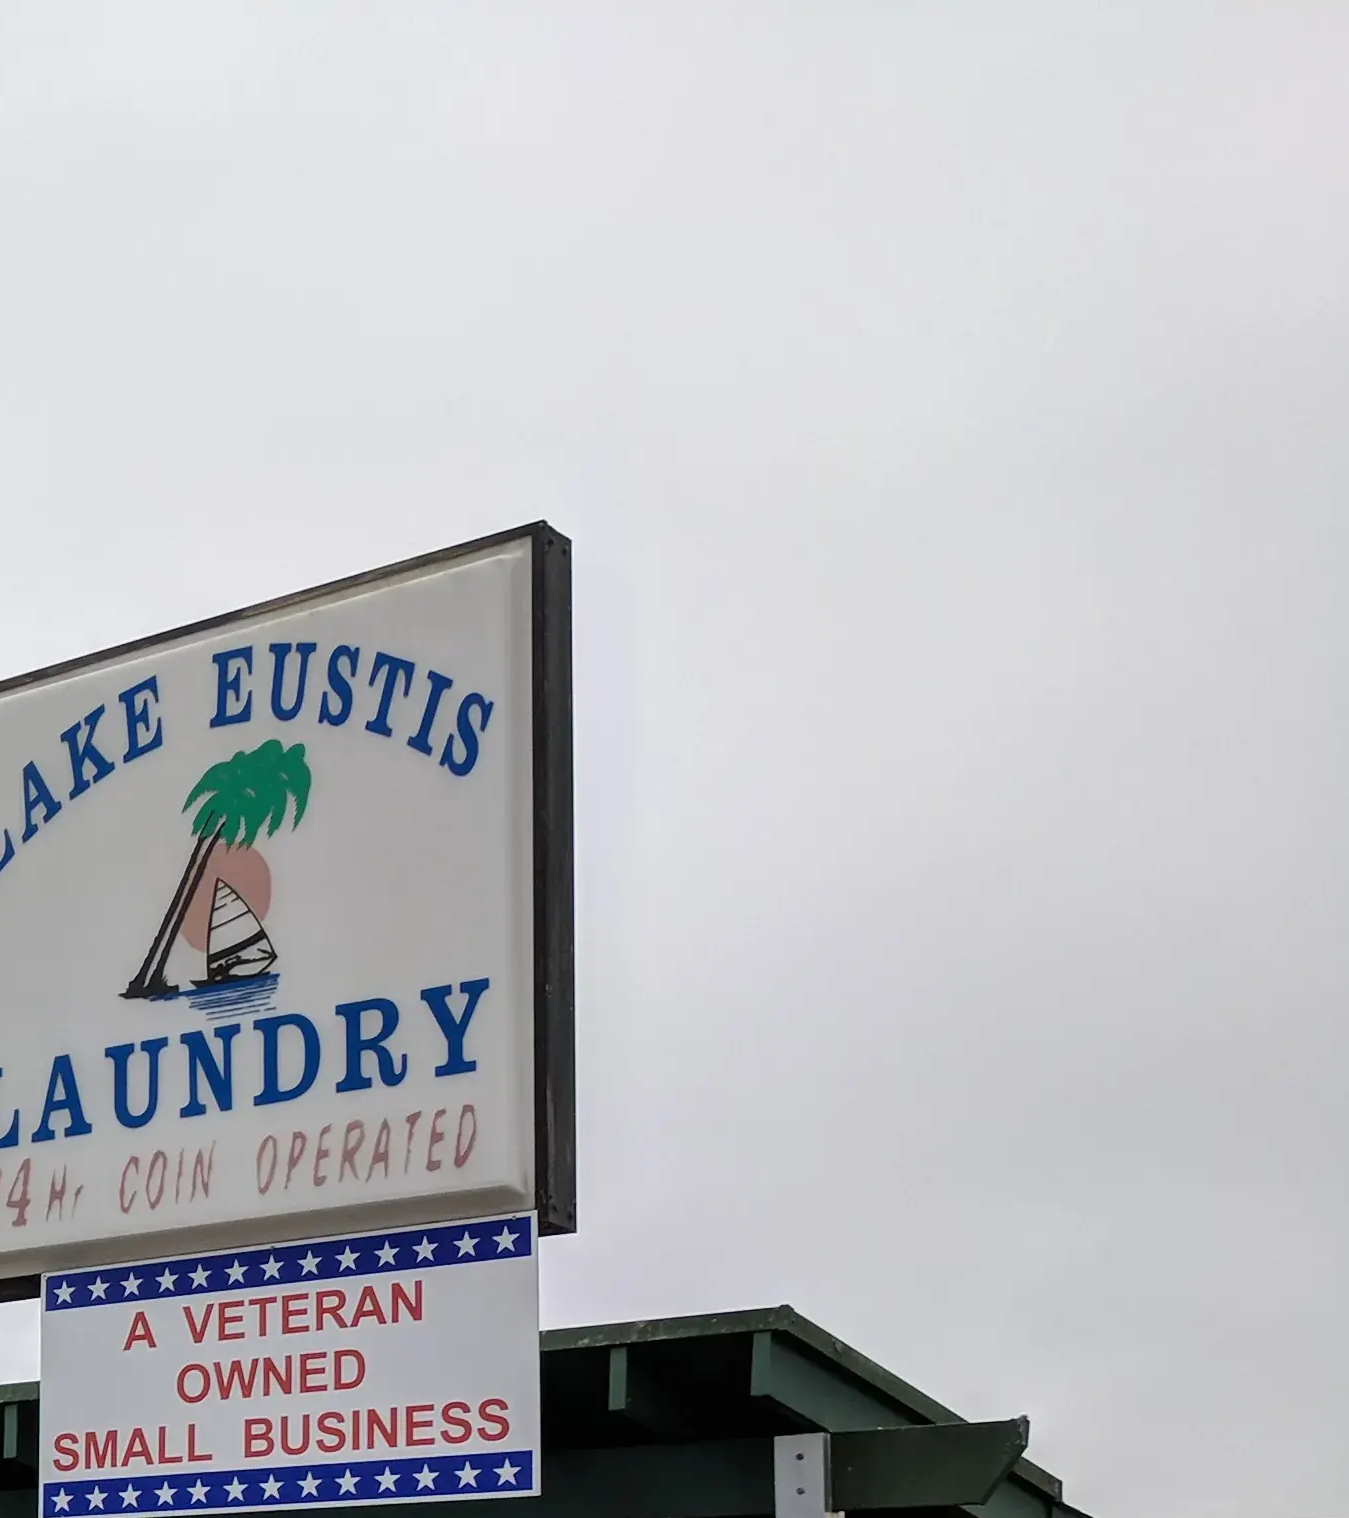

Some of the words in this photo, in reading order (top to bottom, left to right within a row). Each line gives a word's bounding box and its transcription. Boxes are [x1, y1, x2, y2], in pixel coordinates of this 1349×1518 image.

[209, 641, 494, 777] EUSTIS
[118, 1139, 218, 1215] COIN
[255, 1103, 479, 1197] OPERATED
[123, 1311, 157, 1351] A
[182, 1280, 423, 1344] VETERAN
[176, 1349, 365, 1404] OWNED
[53, 1423, 213, 1472] SMALL
[243, 1397, 511, 1459] BUSINESS
